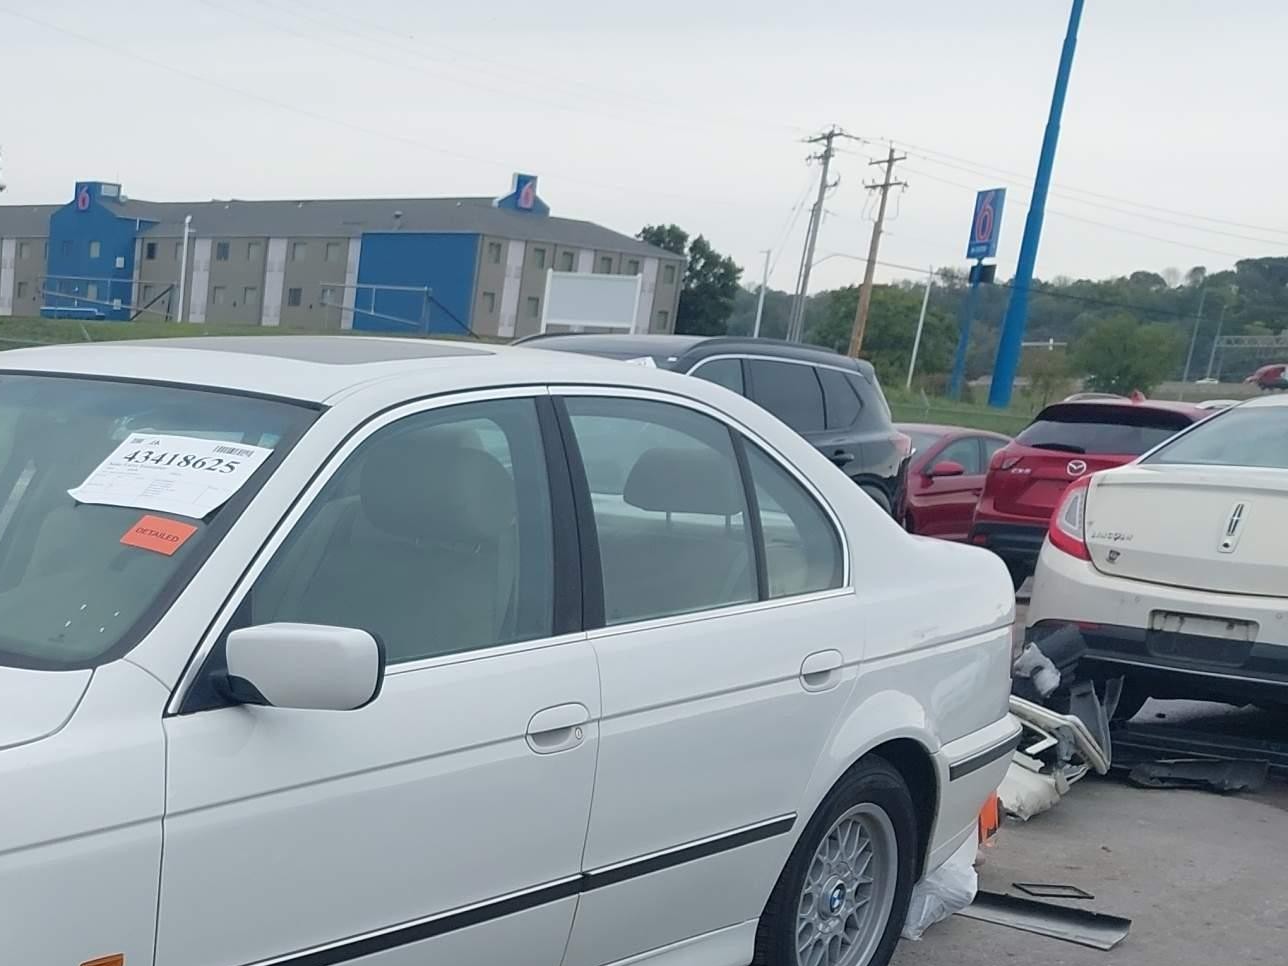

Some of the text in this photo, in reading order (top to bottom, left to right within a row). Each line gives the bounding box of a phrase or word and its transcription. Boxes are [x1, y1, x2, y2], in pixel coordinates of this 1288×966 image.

[78, 185, 90, 210] 6
[519, 181, 534, 209] 6
[976, 191, 994, 241] 6
[123, 450, 241, 474] 43418625
[136, 528, 179, 542] DETAILED
